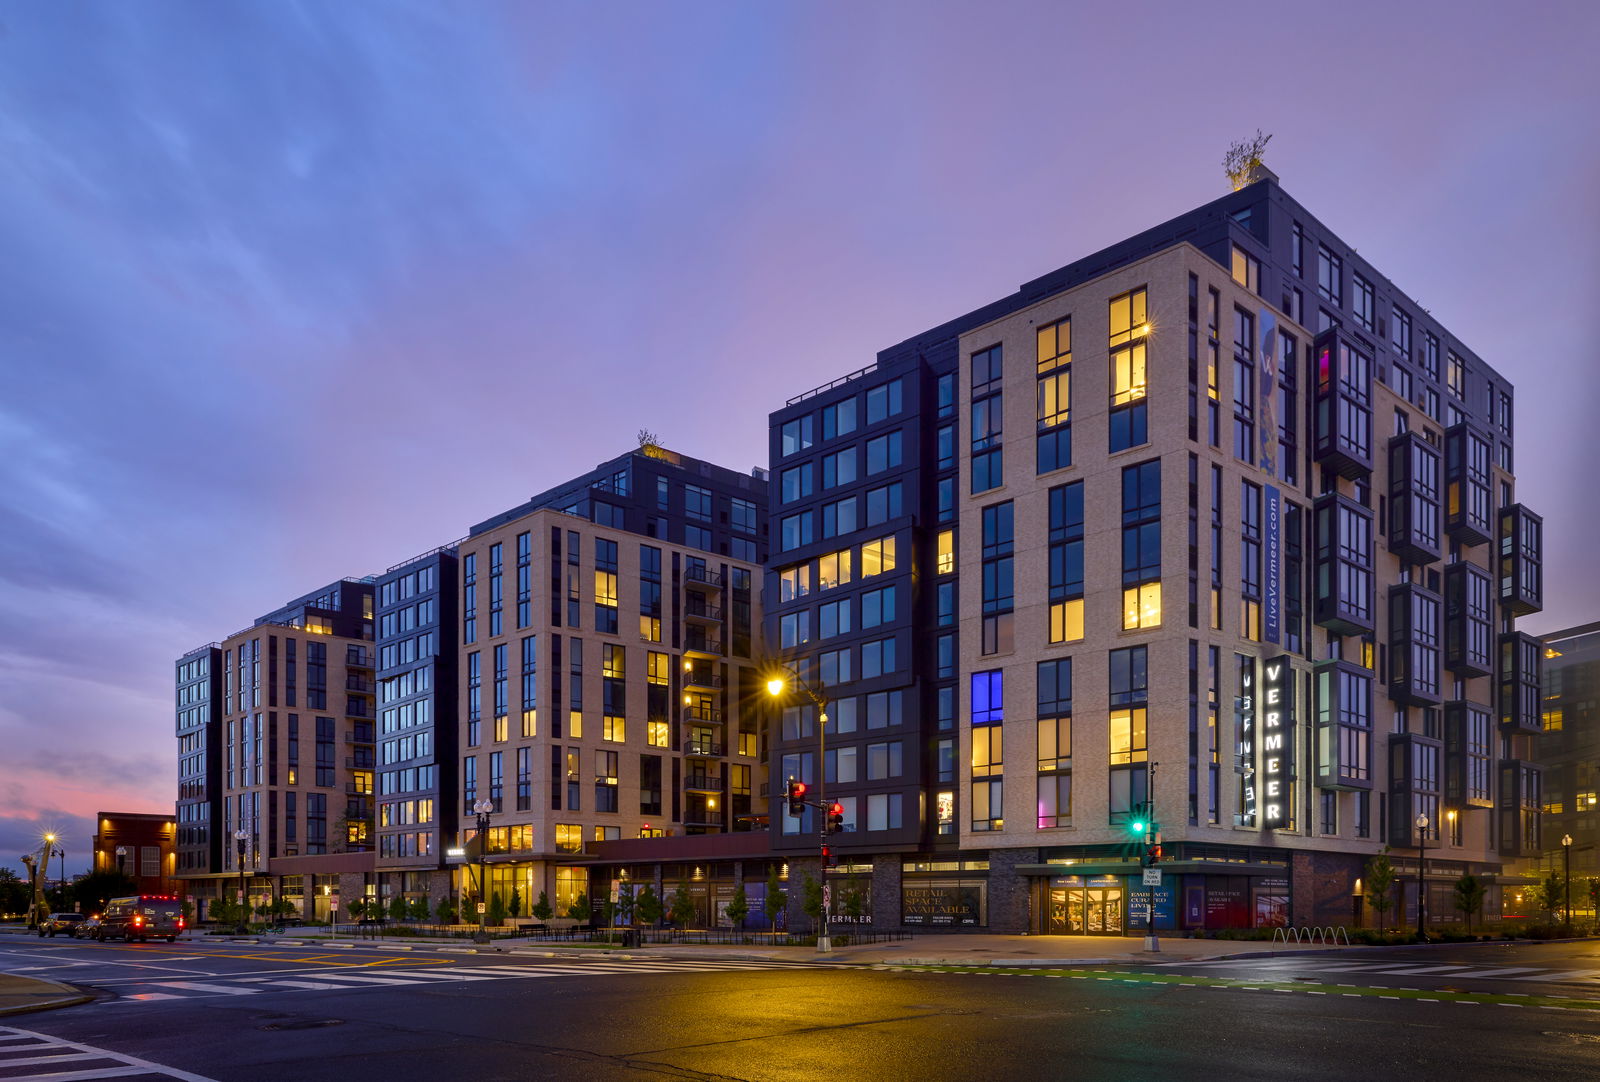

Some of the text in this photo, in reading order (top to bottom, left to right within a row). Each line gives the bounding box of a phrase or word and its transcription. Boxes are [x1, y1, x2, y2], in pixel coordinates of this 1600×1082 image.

[1269, 498, 1277, 628] LiveVermeer.com
[1265, 664, 1282, 820] VERMEER
[906, 889, 948, 897] RETAIL
[905, 897, 942, 905] SPACE
[905, 905, 970, 914] AVAILABLE
